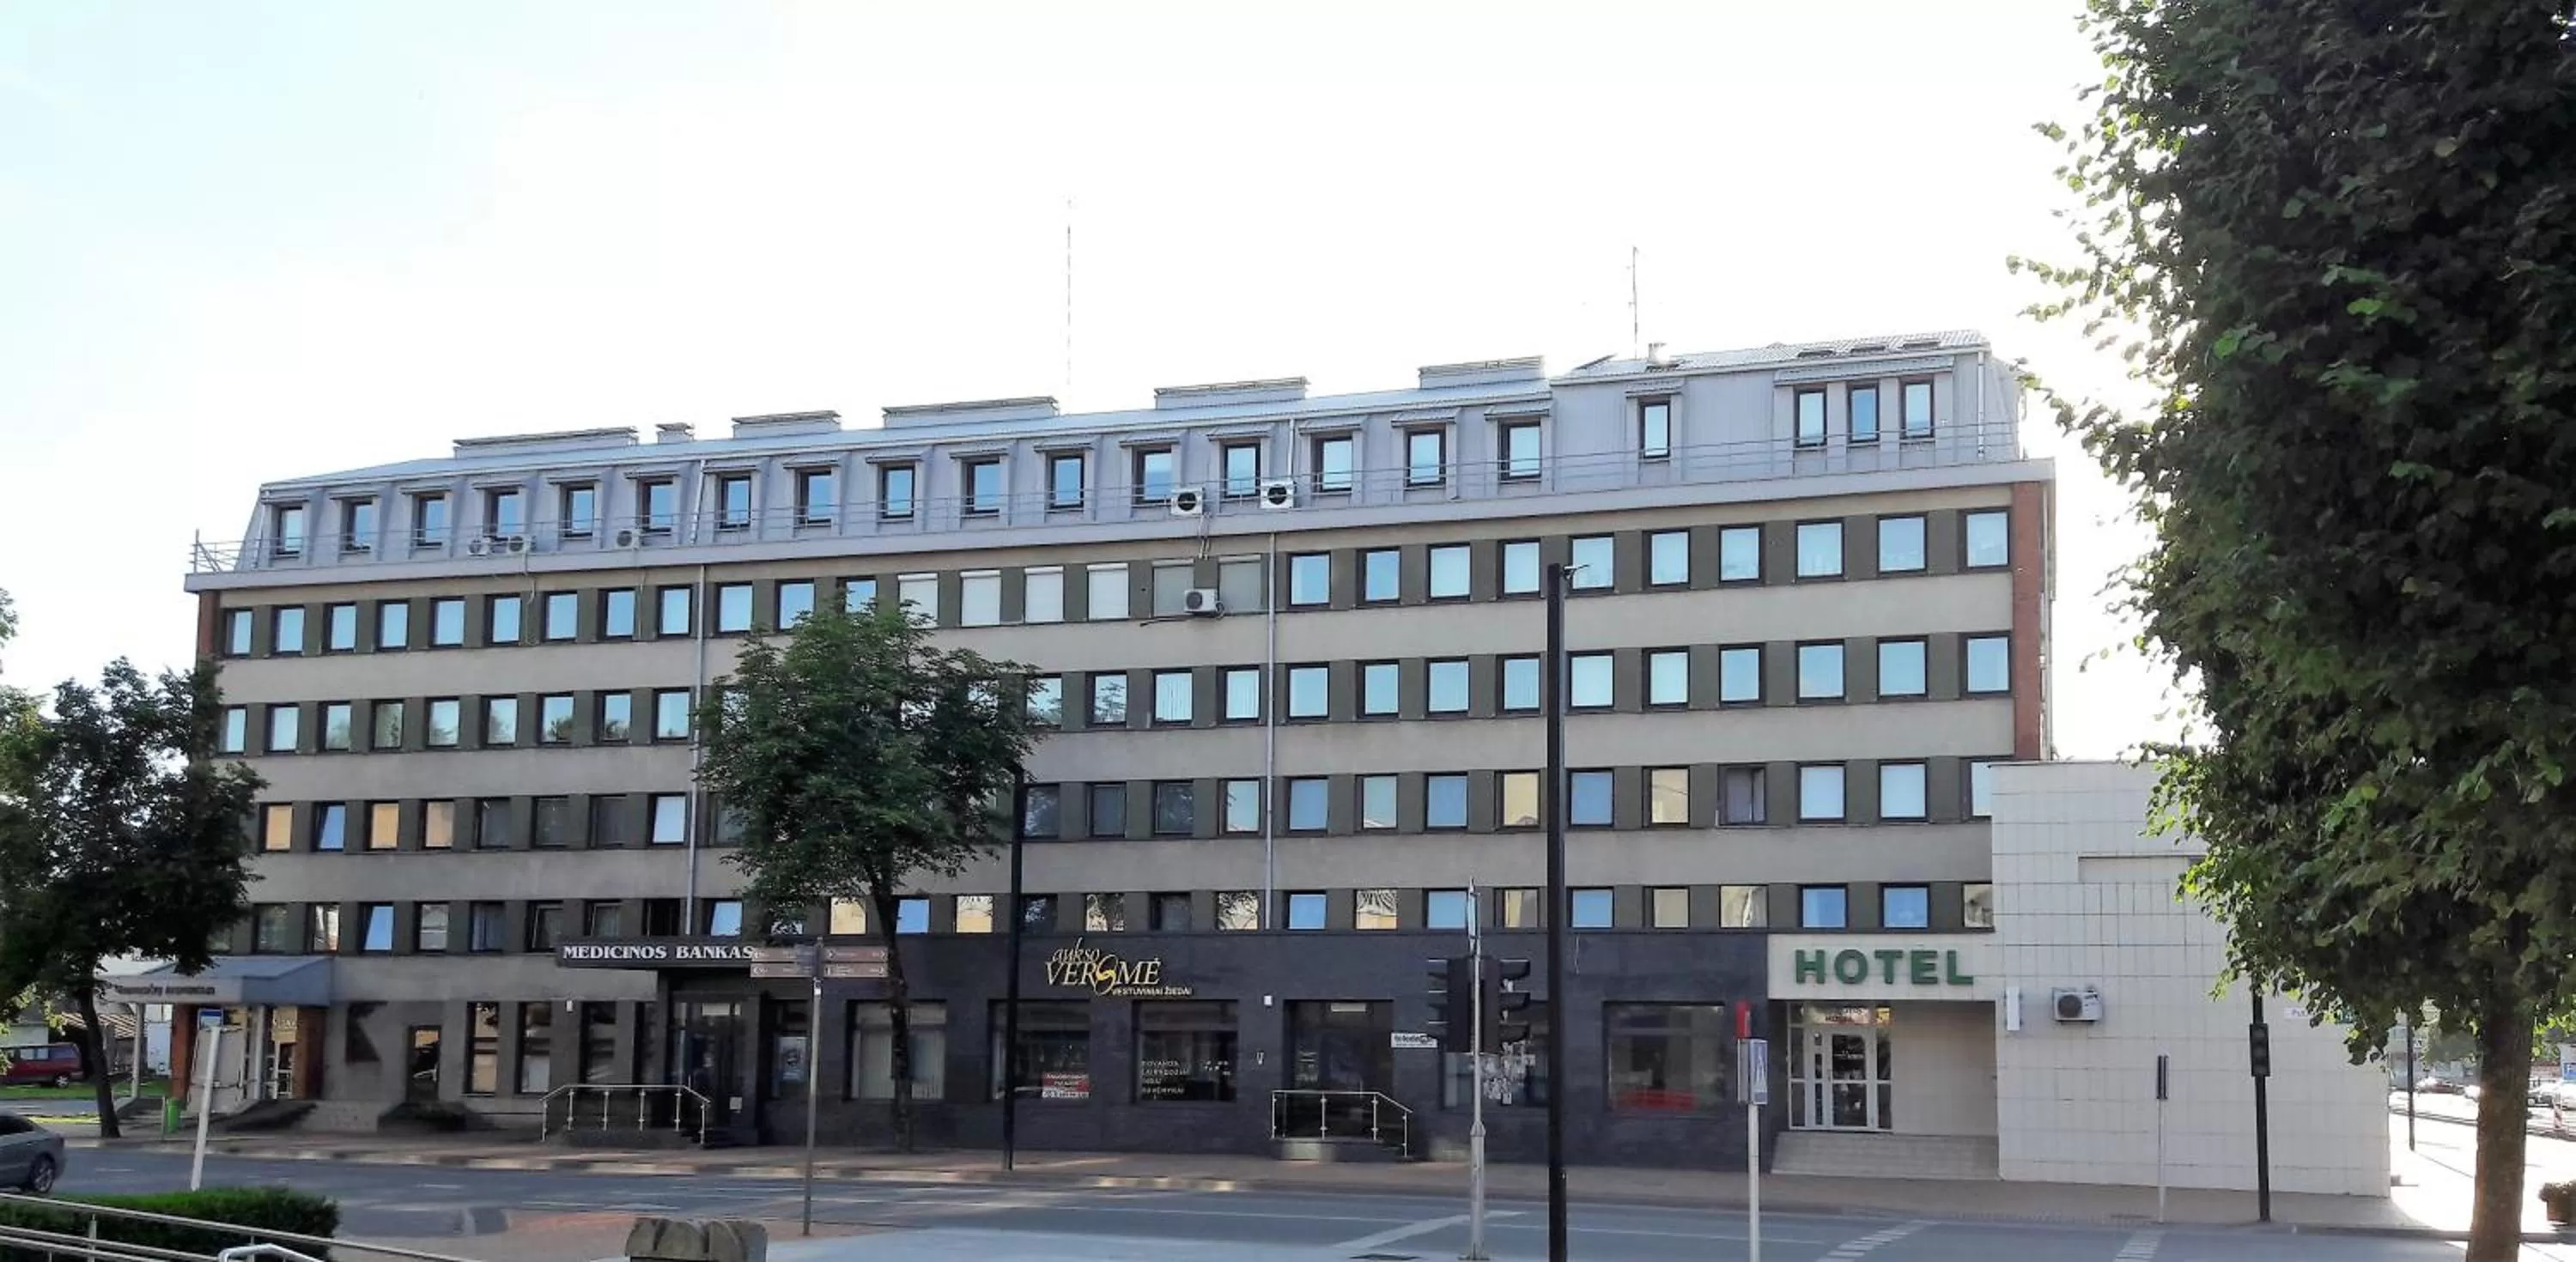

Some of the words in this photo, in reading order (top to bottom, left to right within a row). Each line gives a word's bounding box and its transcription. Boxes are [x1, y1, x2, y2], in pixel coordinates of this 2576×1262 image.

[563, 945, 667, 959] MEDICINOS
[676, 945, 754, 959] BANKAS
[1053, 937, 1100, 964] aukso
[1795, 949, 1974, 985] HOTEL
